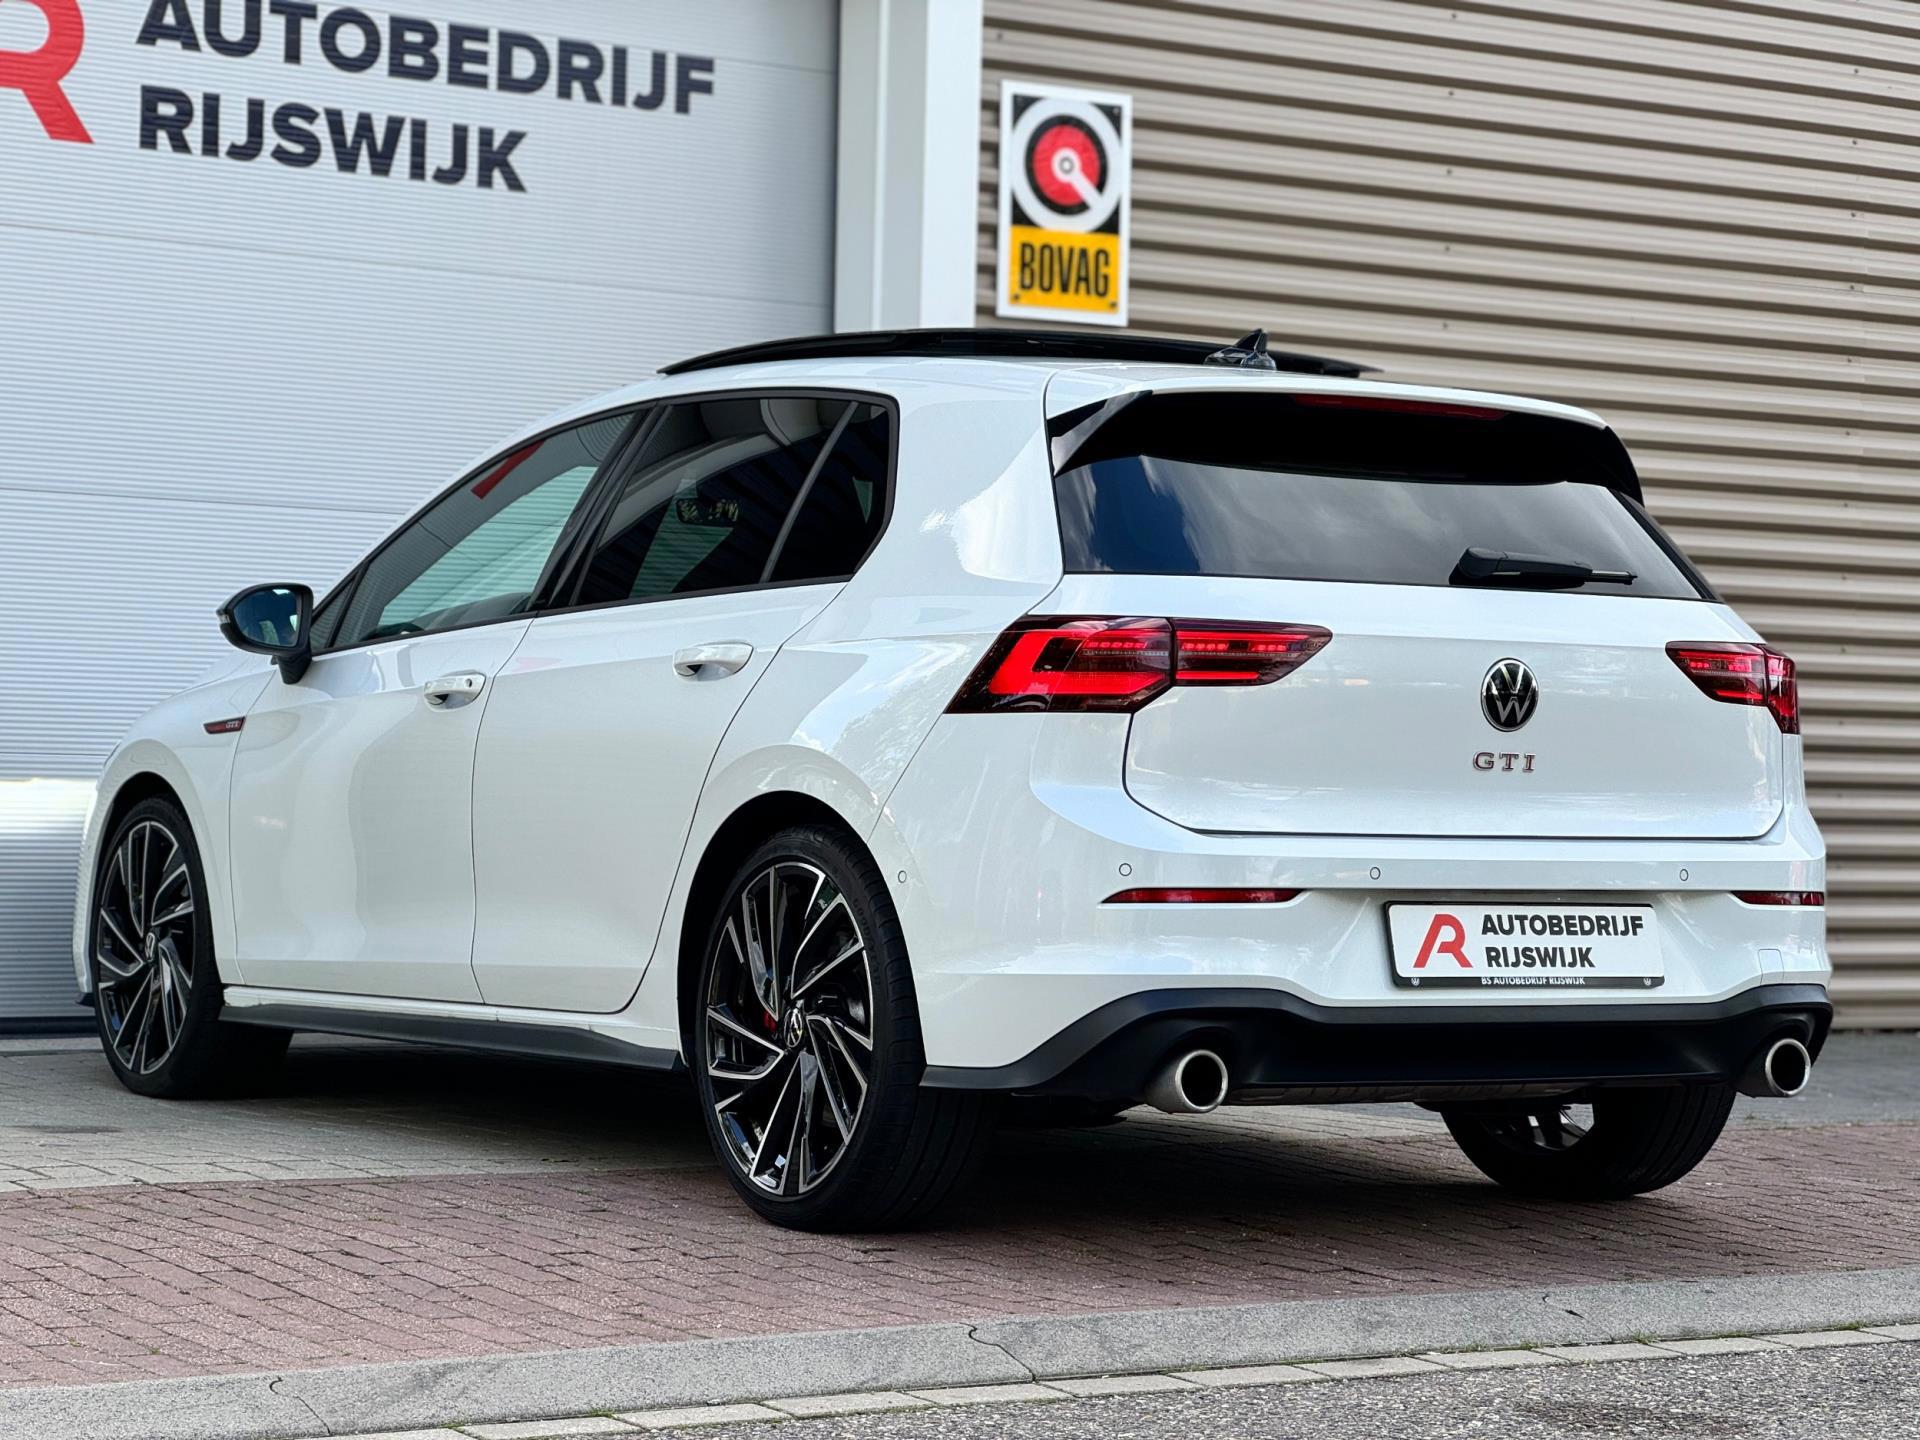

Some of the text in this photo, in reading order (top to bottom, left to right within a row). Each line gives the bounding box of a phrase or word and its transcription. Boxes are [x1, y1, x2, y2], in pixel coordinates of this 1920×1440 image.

[136, 0, 715, 116] AUTOBEDRIJF
[139, 85, 527, 193] RIJSWIJK
[1020, 242, 1110, 297] BOVAG
[1473, 751, 1536, 772] GTI
[1481, 914, 1644, 936] AUTOBEDRIJF
[1485, 946, 1596, 968] RIJSWIJK
[1481, 976, 1586, 985] BS AUTOBEDRIJF RIJSWIJK
